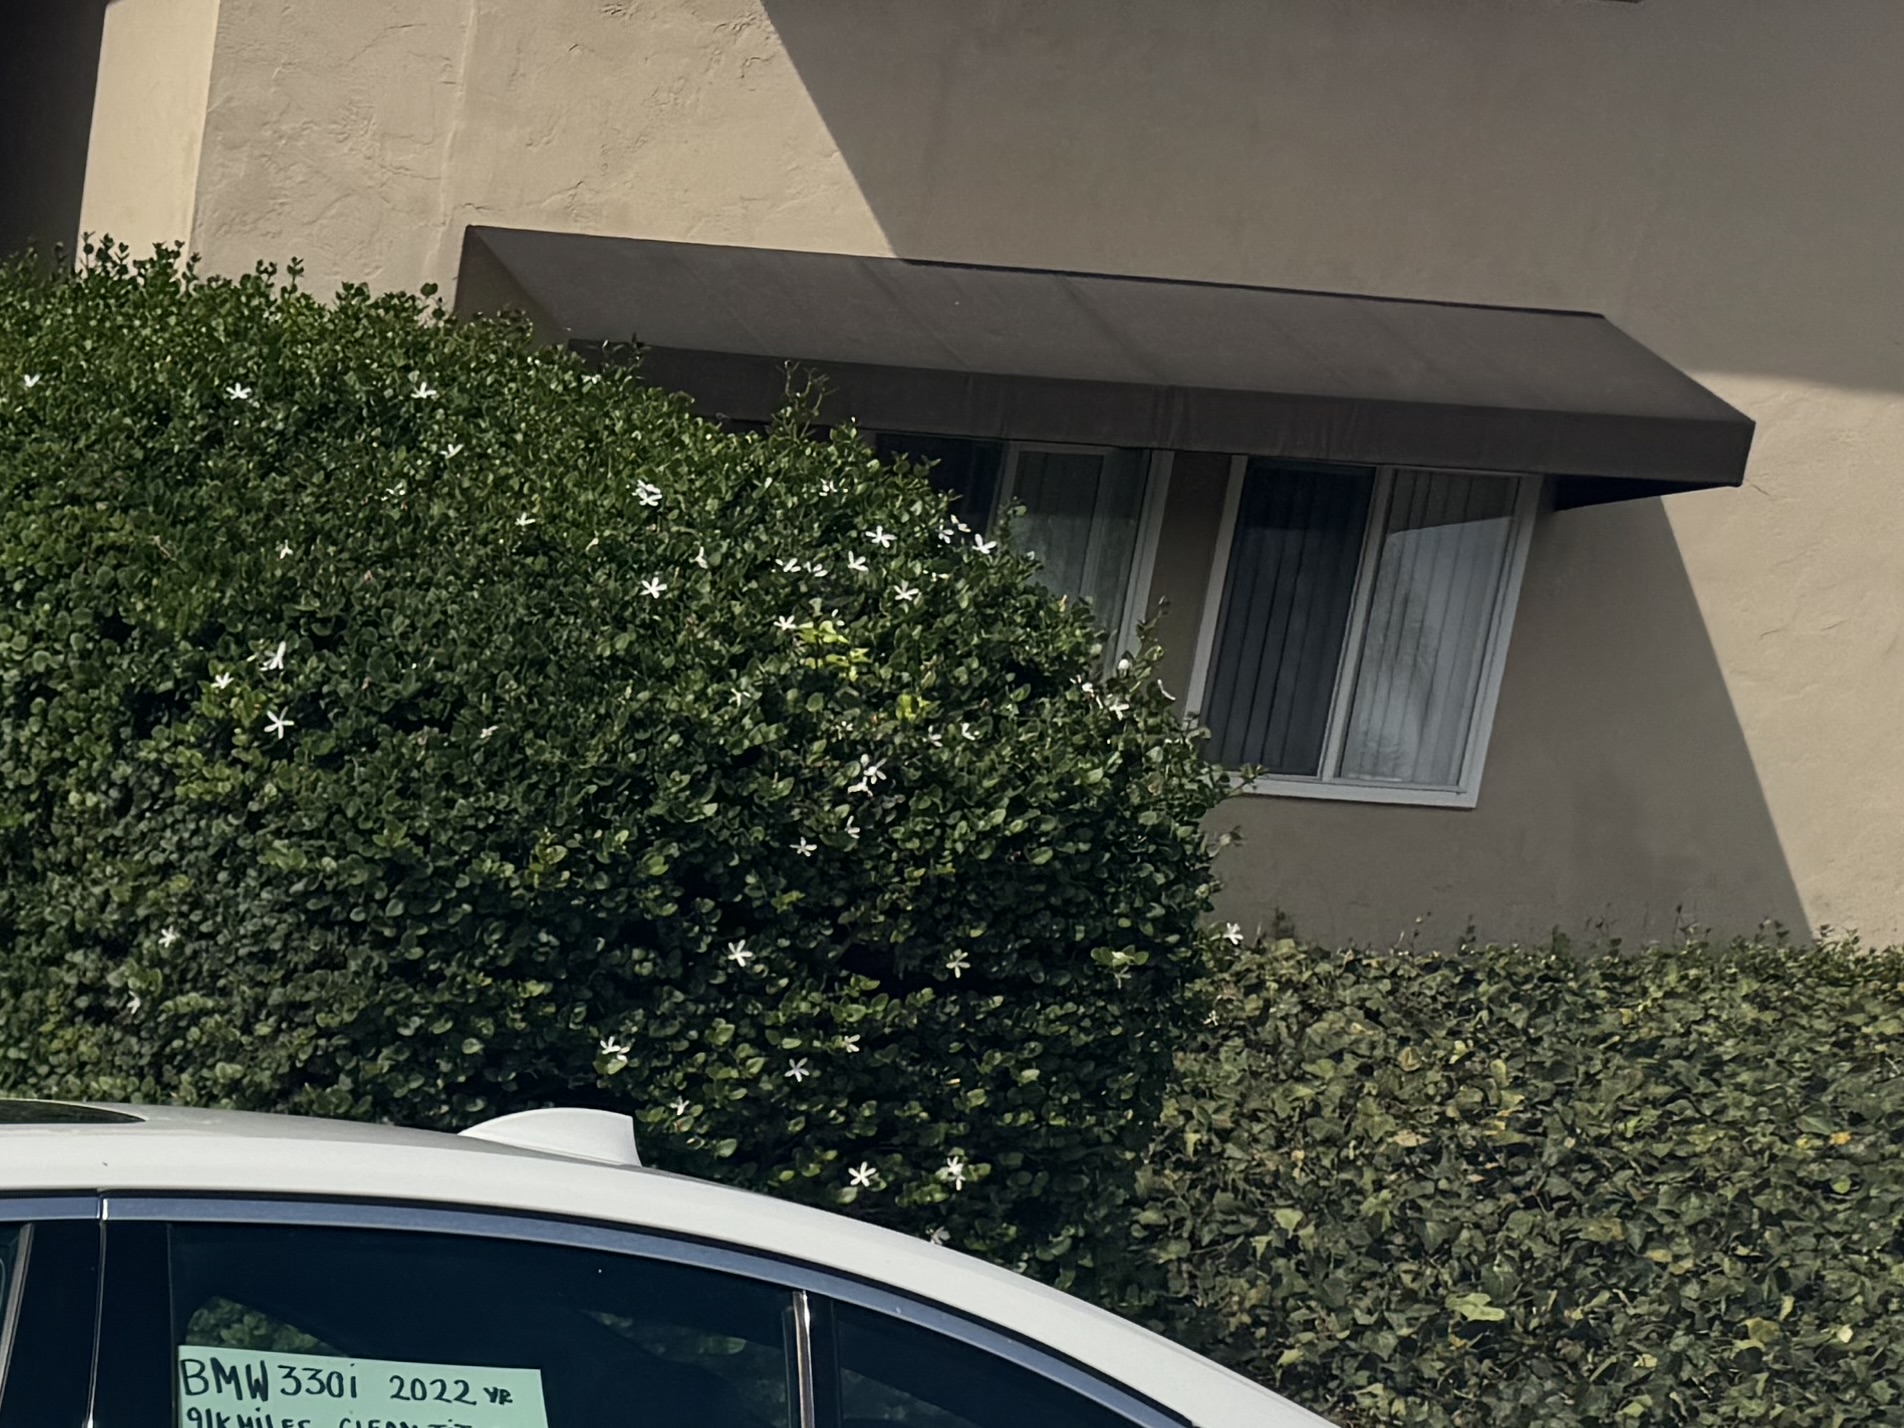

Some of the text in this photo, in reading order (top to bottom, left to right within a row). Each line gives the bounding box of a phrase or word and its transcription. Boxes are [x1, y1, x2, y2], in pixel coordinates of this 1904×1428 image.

[179, 1357, 514, 1406] BMW 330i 2022 YR
